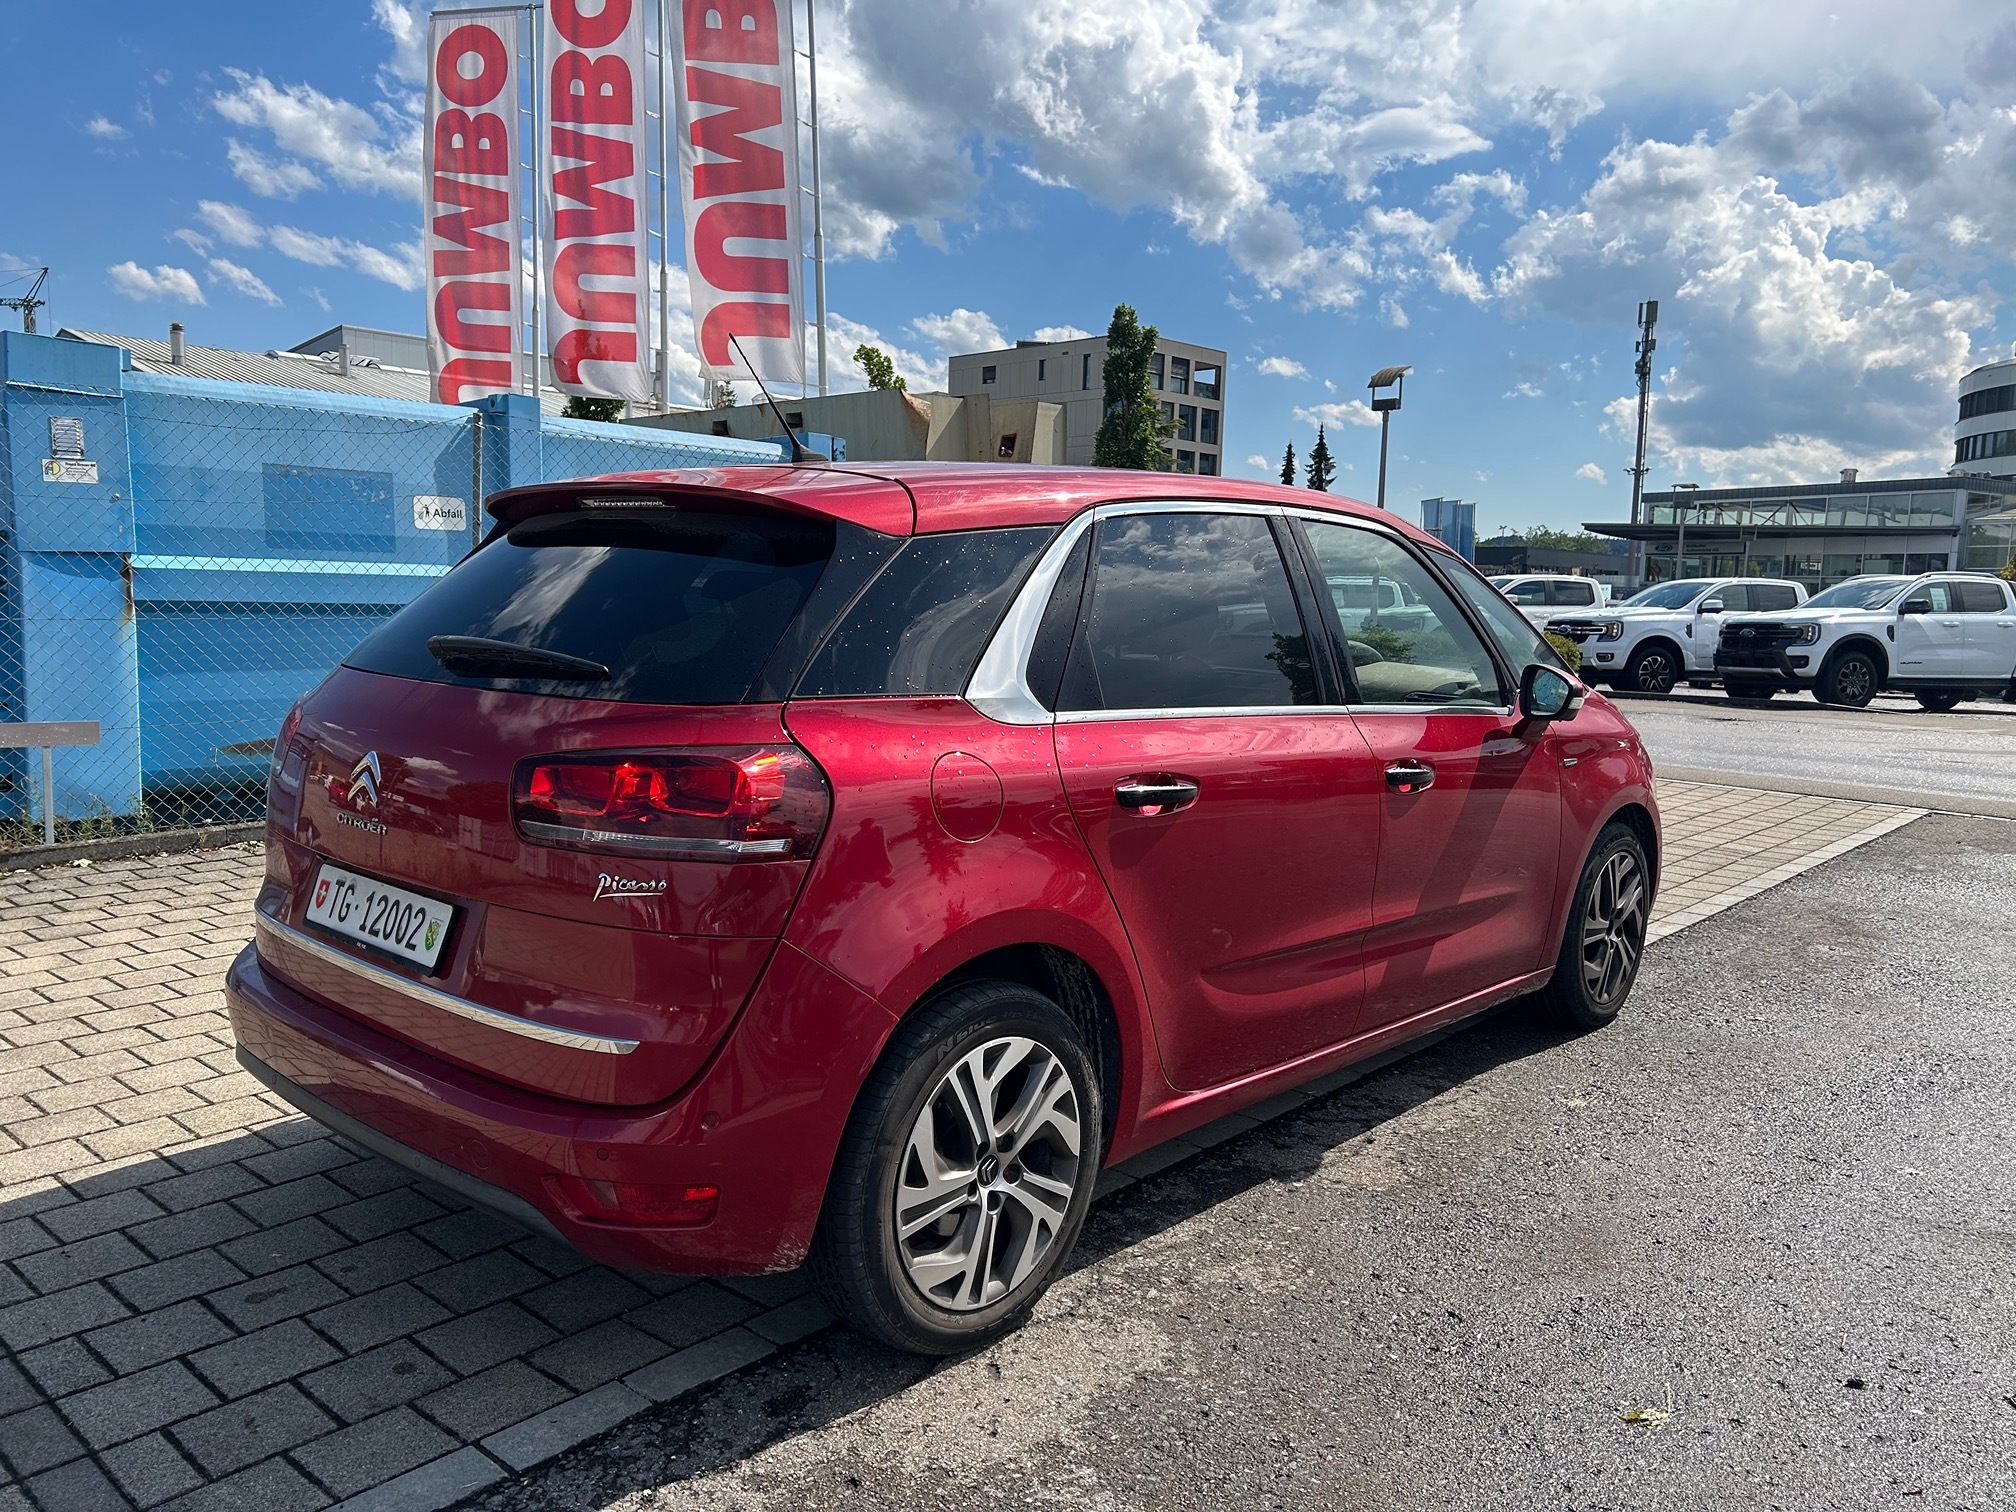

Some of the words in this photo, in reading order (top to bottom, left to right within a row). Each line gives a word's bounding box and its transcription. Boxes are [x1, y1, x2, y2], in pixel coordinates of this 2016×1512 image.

[433, 24, 512, 403] JUMBO
[433, 508, 464, 519] Abfall
[592, 872, 667, 902] Picasso
